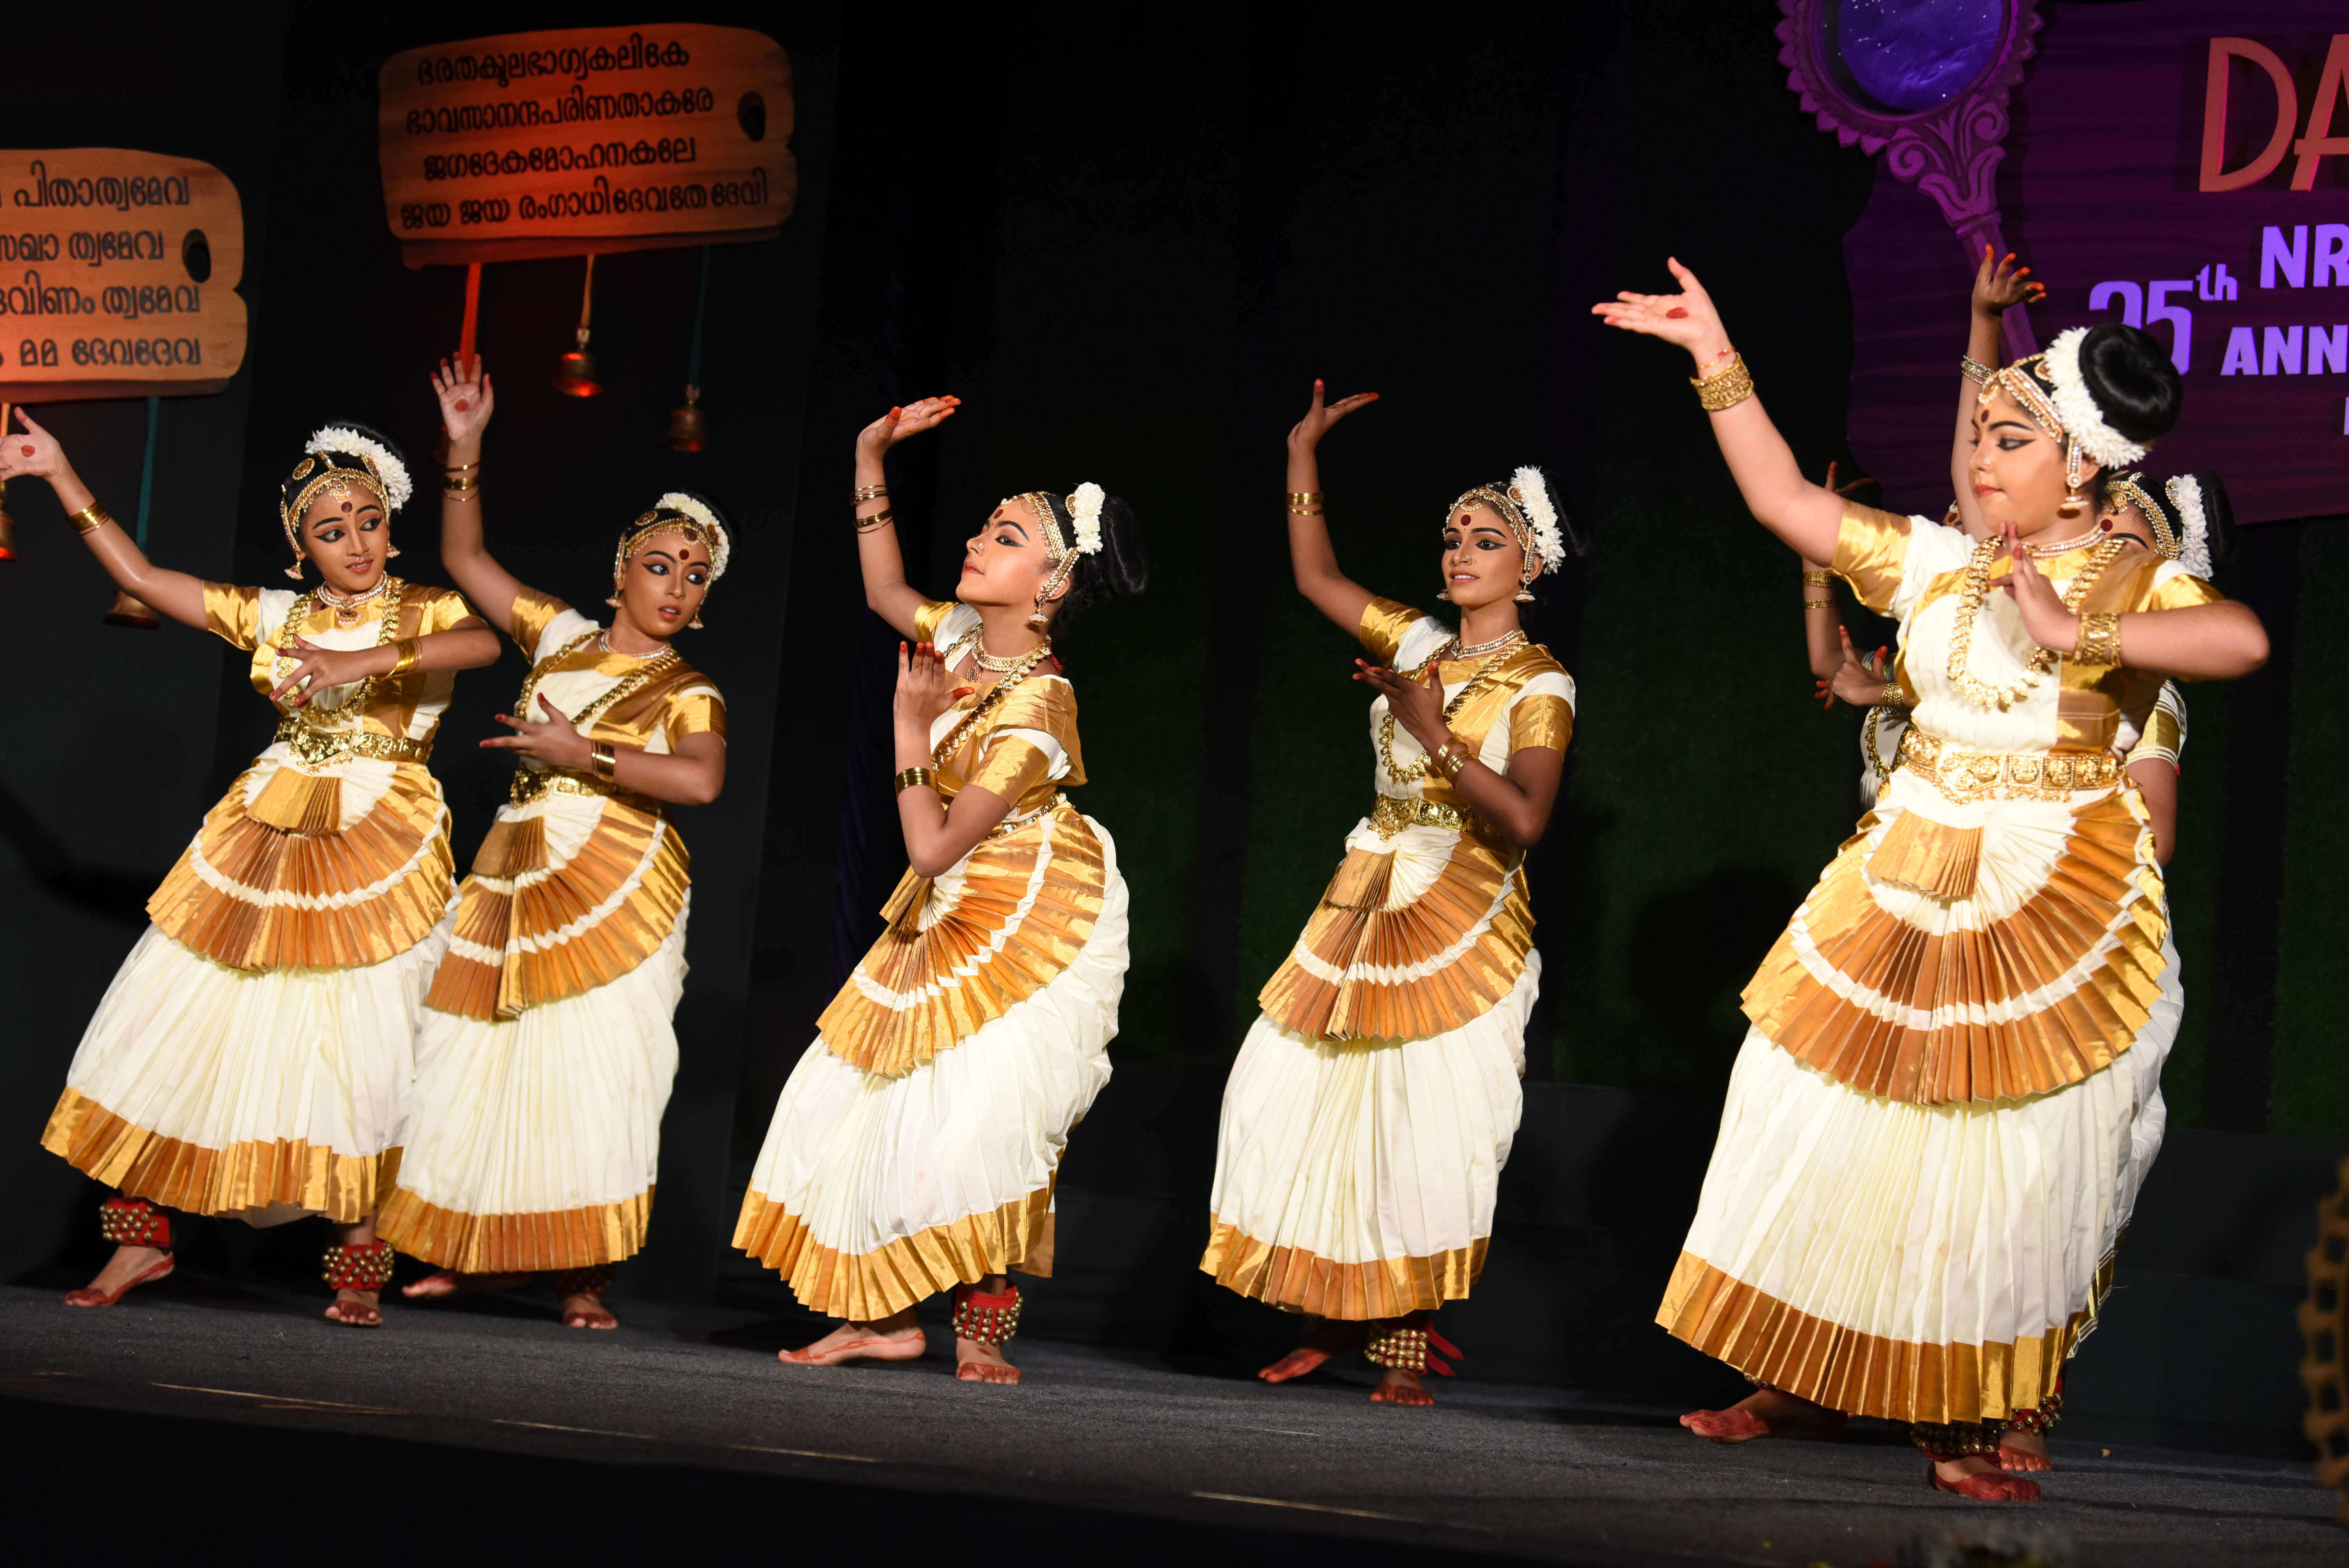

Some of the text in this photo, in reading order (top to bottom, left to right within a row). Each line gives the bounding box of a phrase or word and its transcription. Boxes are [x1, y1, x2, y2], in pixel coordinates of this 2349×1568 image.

[14, 160, 189, 210] പിതാത്വമേവ
[401, 203, 450, 229] ജയ
[460, 199, 509, 224] ജയ
[69, 231, 163, 267] ത്വമേവ
[103, 285, 199, 319] ത്വമേവ
[21, 339, 58, 366] മമ
[73, 338, 200, 365] ദേവദേവ
[2221, 325, 2348, 376] ANN
